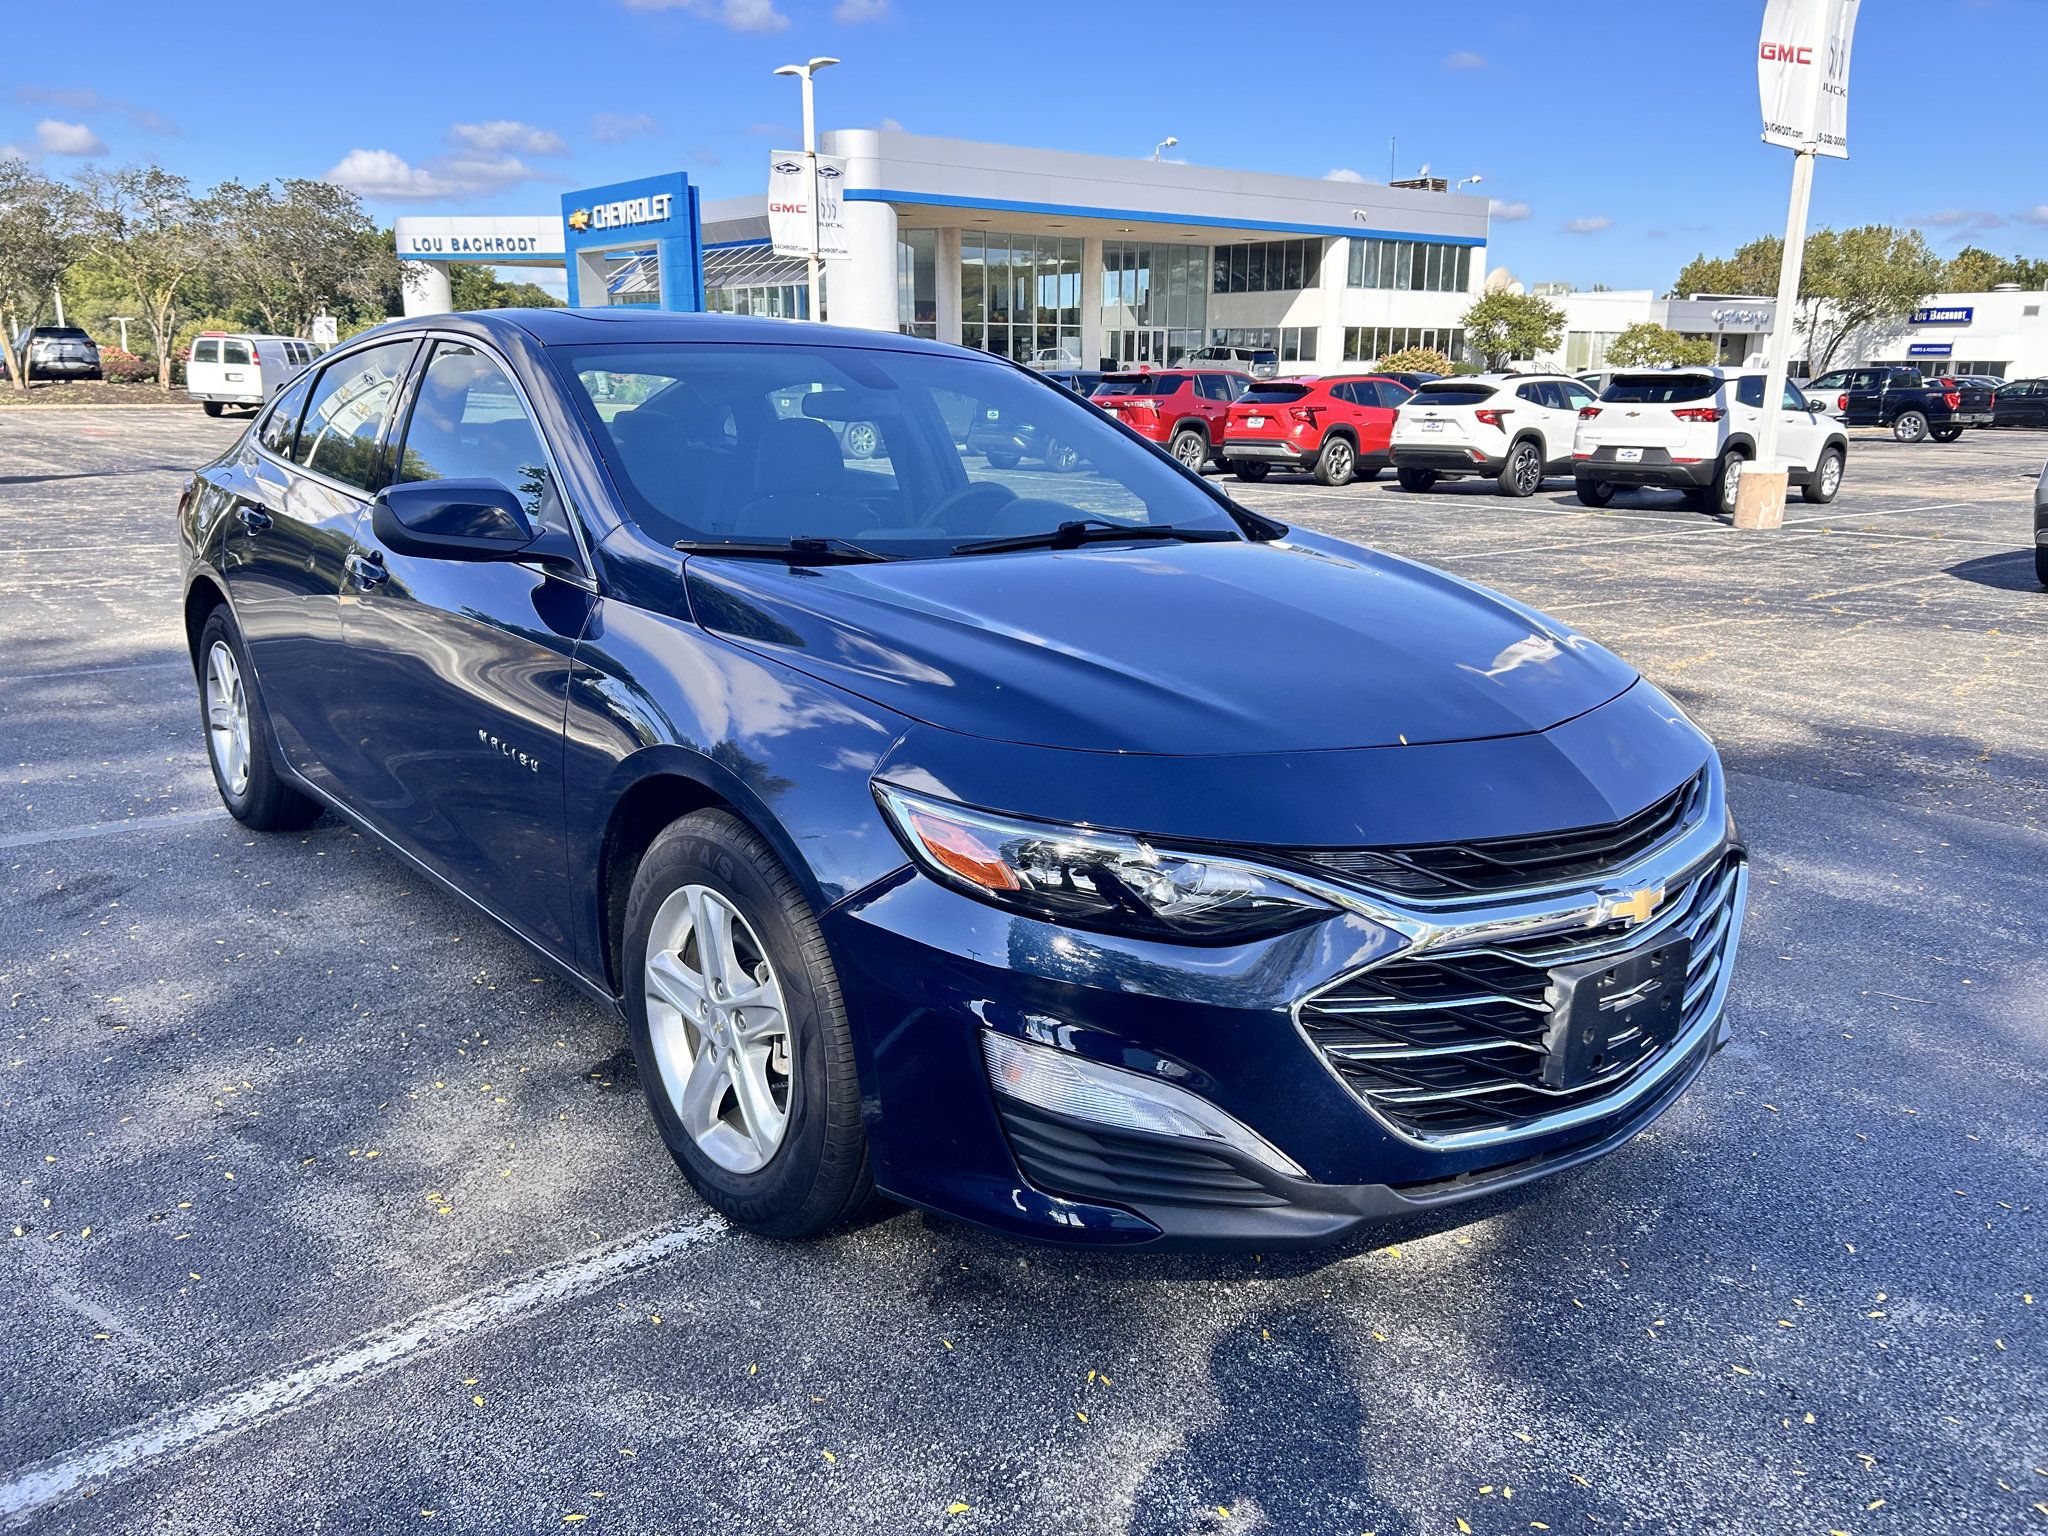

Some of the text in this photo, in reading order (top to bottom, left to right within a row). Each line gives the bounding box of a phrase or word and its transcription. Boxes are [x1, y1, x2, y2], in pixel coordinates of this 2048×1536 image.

[1761, 42, 1813, 65] GMC
[593, 193, 673, 230] CHEVROLET
[770, 203, 807, 214] GMC
[412, 237, 537, 252] LOU BACHRODT
[478, 729, 538, 772] MALIBU
